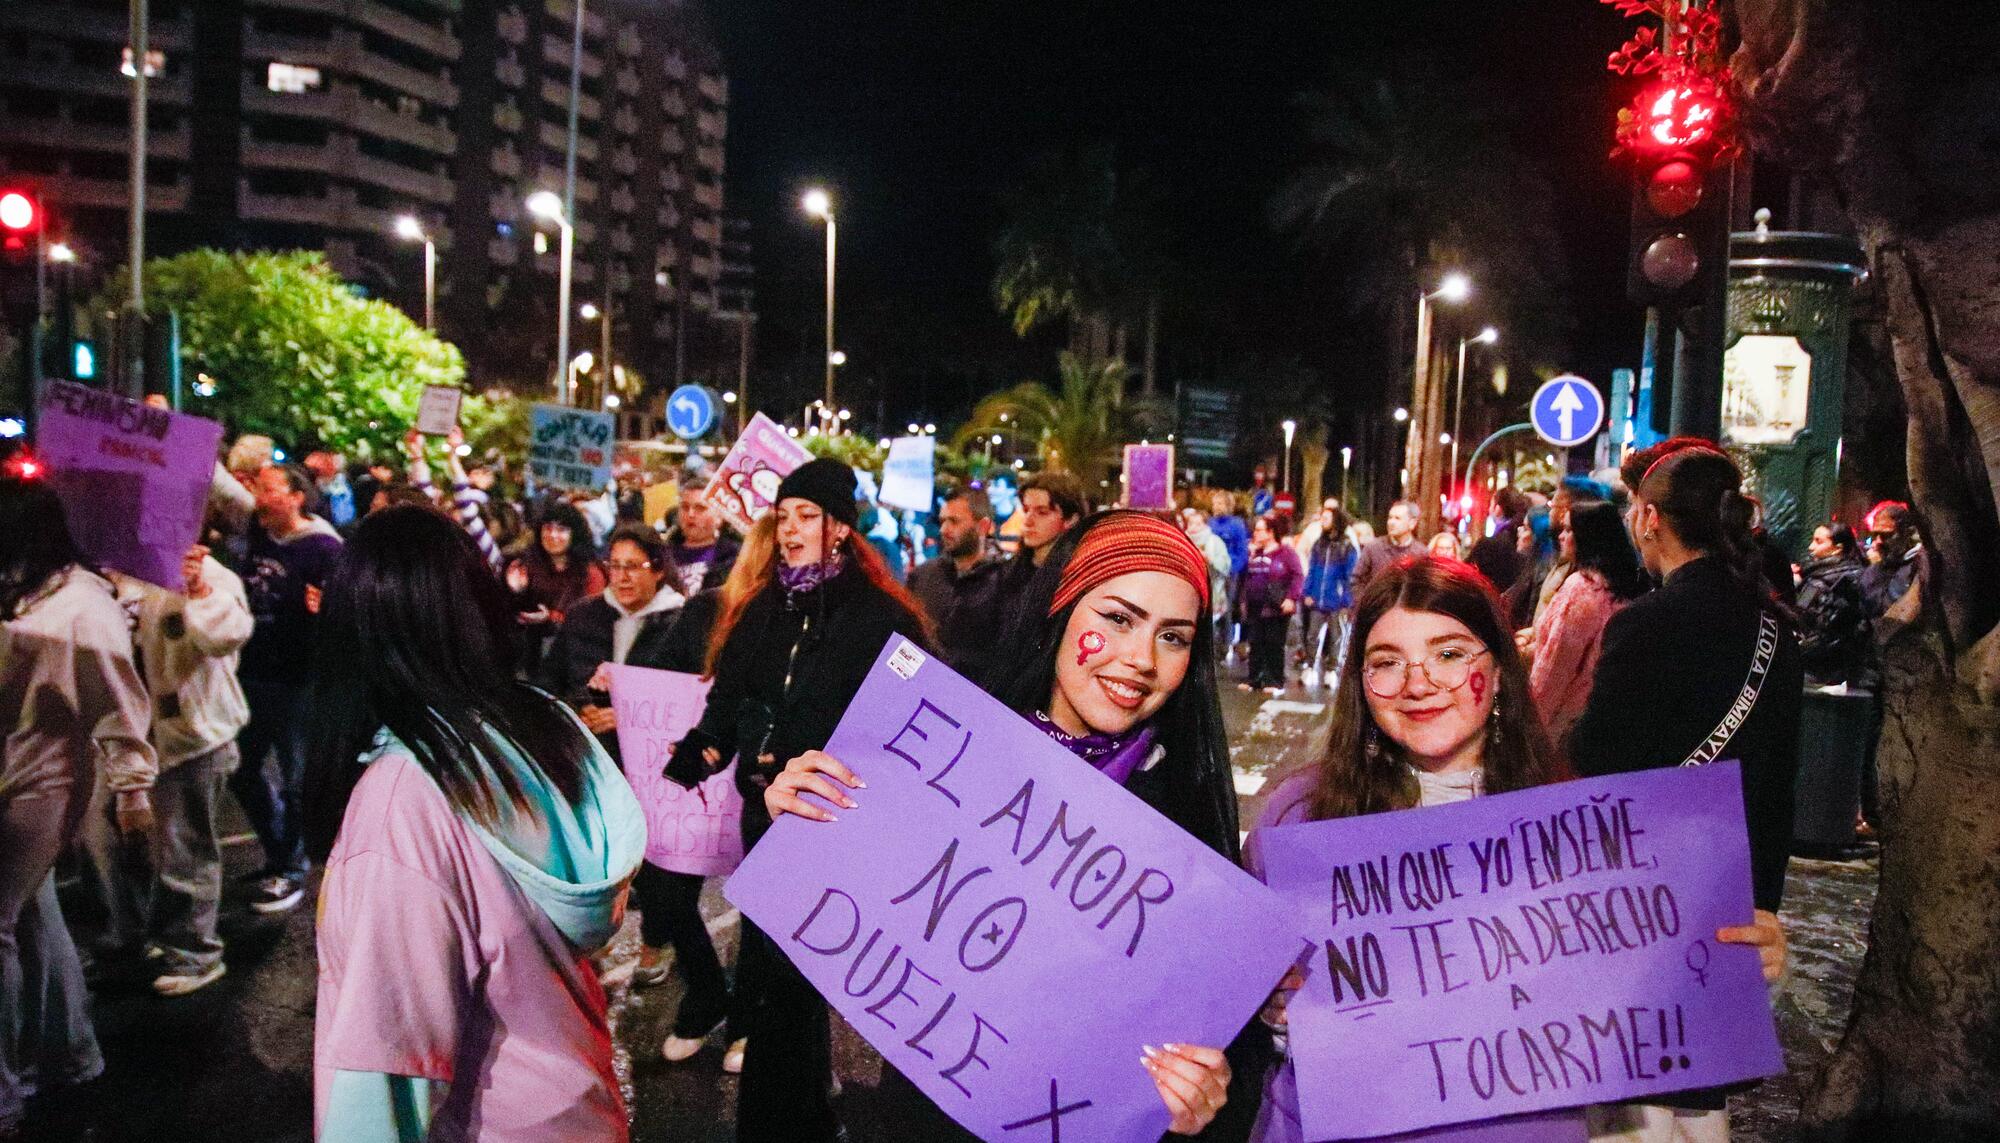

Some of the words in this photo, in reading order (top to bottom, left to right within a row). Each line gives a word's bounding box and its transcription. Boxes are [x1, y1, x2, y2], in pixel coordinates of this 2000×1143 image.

[883, 698, 972, 808] EL
[980, 778, 1175, 958] AMOR
[1468, 836, 1513, 894] YO
[891, 837, 1029, 973] NO
[1326, 932, 1391, 1003] NO
[1390, 918, 1470, 998] TE
[1467, 915, 1531, 982] DA
[1518, 884, 1680, 966] DERECHO
[791, 887, 1009, 1099] DUELE
[1510, 983, 1532, 1011] A
[1408, 1003, 1692, 1103] TOCARME!!
